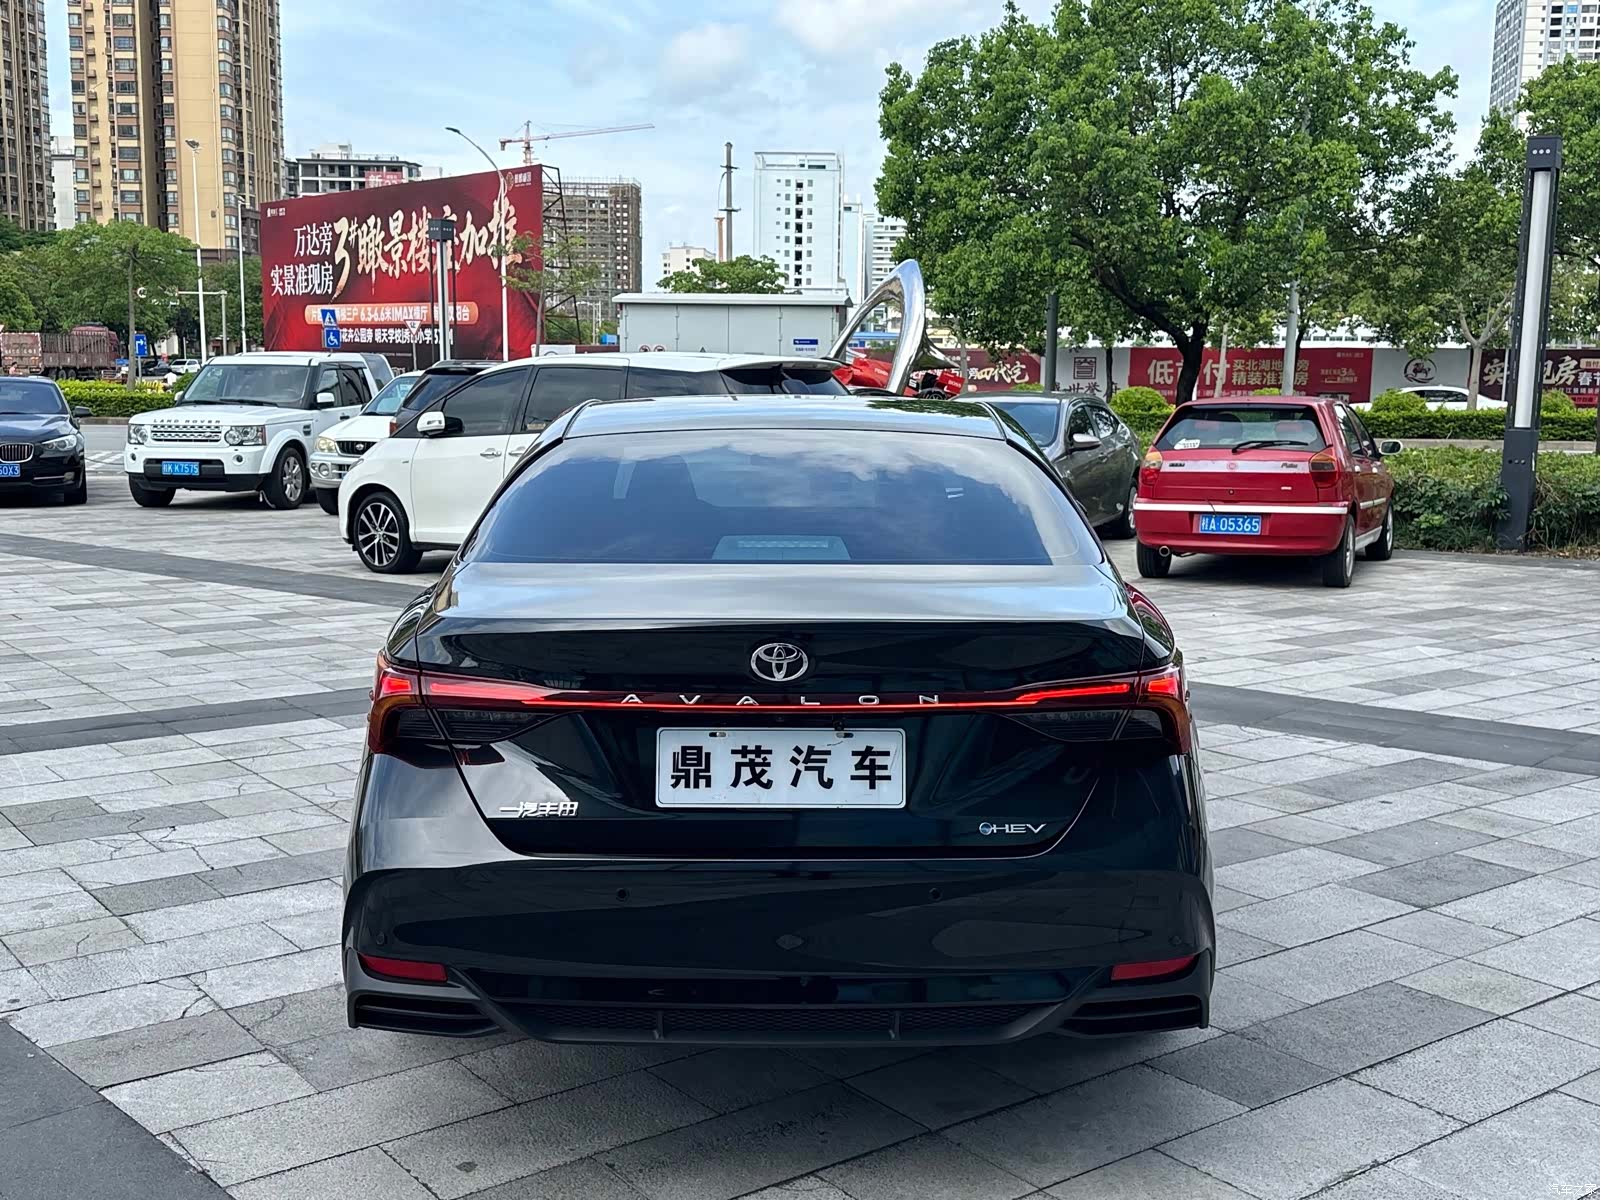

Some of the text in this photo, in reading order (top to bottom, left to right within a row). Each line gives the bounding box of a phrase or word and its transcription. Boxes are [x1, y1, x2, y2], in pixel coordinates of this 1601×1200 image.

[294, 221, 333, 258] 万达旁
[270, 261, 334, 297] 实景准现房
[1147, 359, 1231, 386] 低付
[1232, 359, 1310, 371] 买北湖地旁
[621, 693, 939, 706] AVALON
[671, 745, 892, 790] 鼎茂汽车
[499, 801, 579, 818] 一汽丰田
